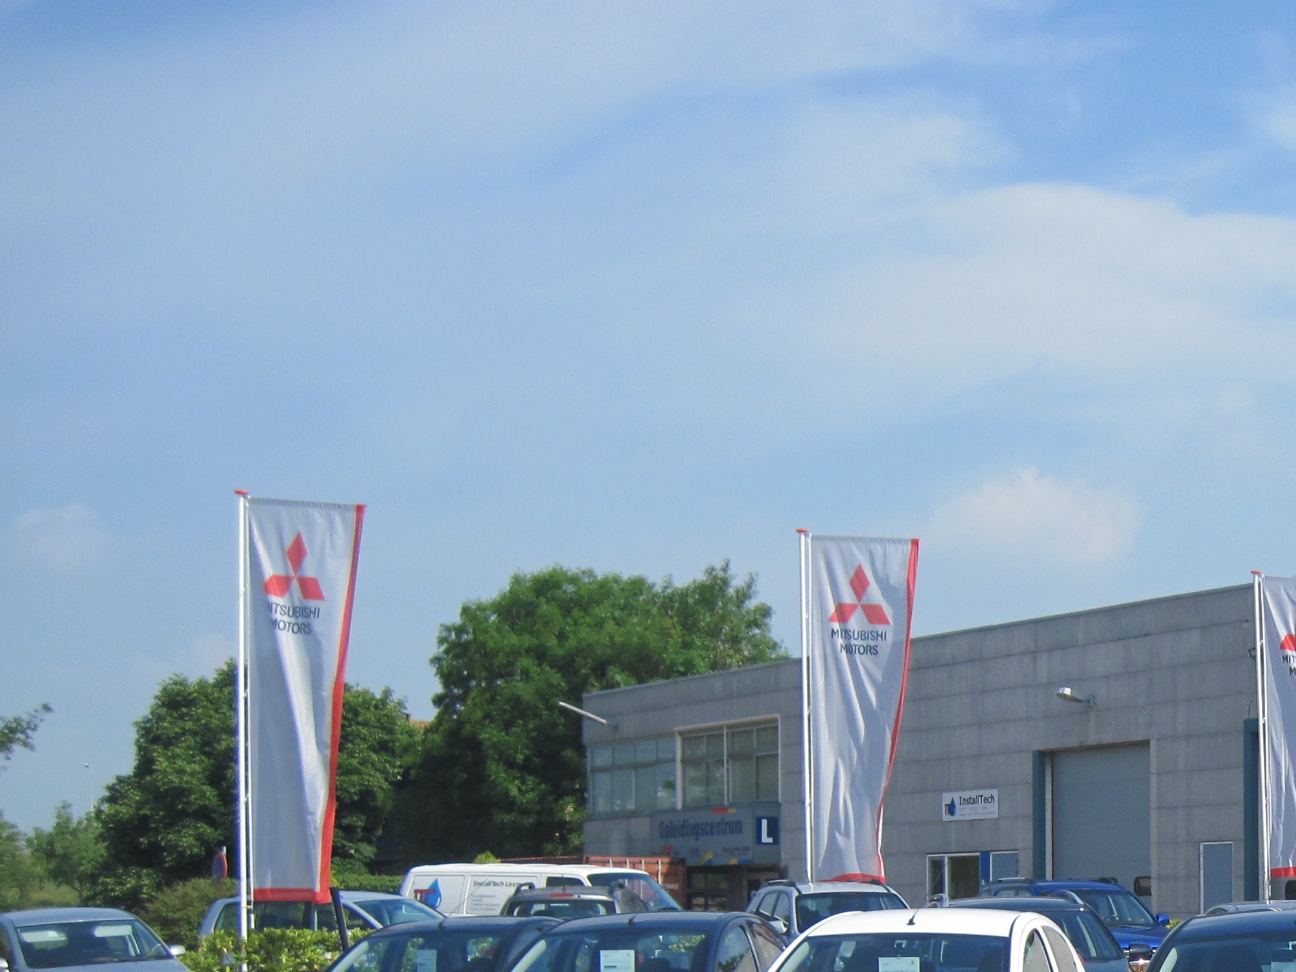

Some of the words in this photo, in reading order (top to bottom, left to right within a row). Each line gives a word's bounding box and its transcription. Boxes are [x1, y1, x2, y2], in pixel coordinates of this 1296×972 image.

[831, 628, 887, 642] MITSUBISHI
[840, 643, 879, 656] MOTORS
[761, 818, 773, 843] L
